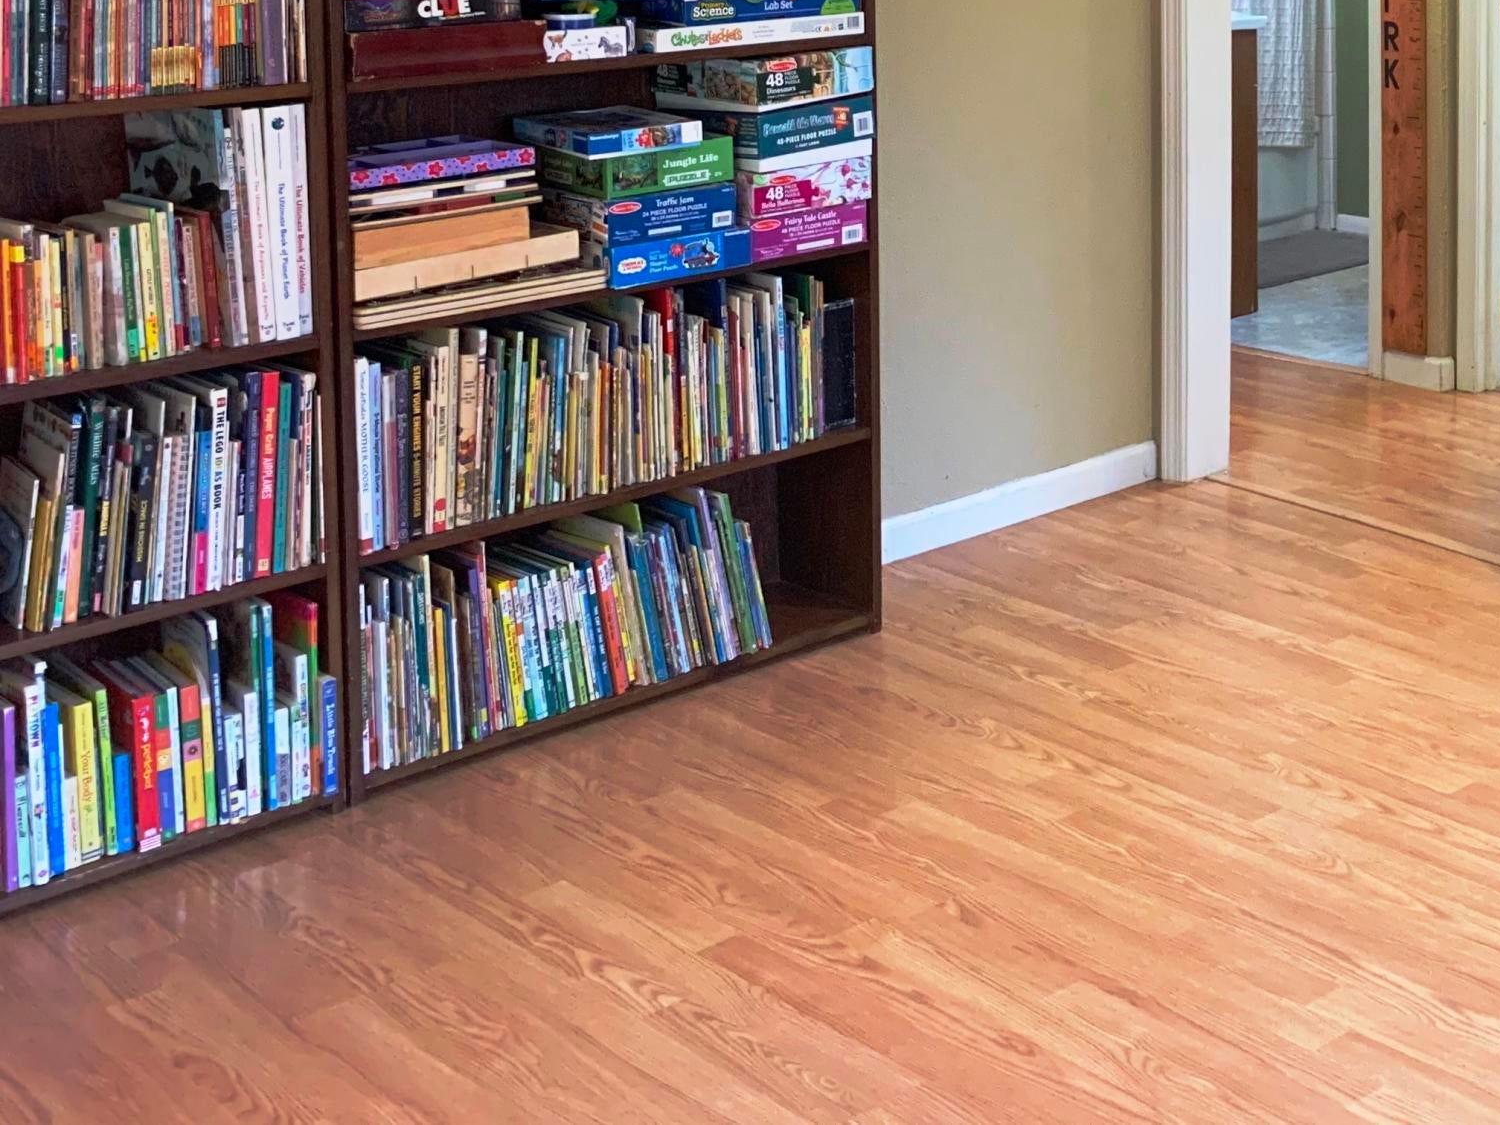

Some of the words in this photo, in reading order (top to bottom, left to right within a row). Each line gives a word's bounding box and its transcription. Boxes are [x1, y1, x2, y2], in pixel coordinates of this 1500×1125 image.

[692, 5, 735, 18] Science
[764, 1, 778, 11] Lab
[780, 0, 793, 10] Set
[765, 73, 784, 87] 48
[766, 86, 796, 96] Dinosaurs
[801, 132, 818, 142] FLOOR
[818, 128, 837, 139] PUZZLE
[663, 155, 697, 169] Jungle
[699, 153, 719, 163] Life
[277, 182, 286, 195] The
[295, 184, 303, 198] The
[765, 186, 784, 200] 48
[279, 196, 287, 228] Ultimate
[650, 208, 667, 216] PIECE
[687, 203, 708, 211] PUZZLE
[656, 196, 678, 207] Traffic
[680, 196, 694, 204] Jam
[296, 199, 304, 232] Ultimate
[784, 216, 802, 226] Fairy
[803, 214, 817, 222] Tale
[817, 210, 837, 221] Castle
[280, 248, 288, 256] of
[297, 234, 305, 253] Book
[282, 257, 290, 279] Planet
[297, 255, 306, 263] of
[283, 281, 291, 300] Earth
[412, 365, 421, 390] START
[413, 391, 422, 414] YOUR
[216, 411, 225, 429] THE
[264, 407, 275, 432] Paper
[90, 421, 103, 459] Wildlife
[215, 431, 224, 454] LEGO
[263, 434, 274, 455] Craft
[360, 422, 369, 462] MOTHER
[413, 417, 421, 451] ENGINES
[90, 464, 100, 486] Atlas
[261, 457, 273, 500] AIRPLANES
[361, 463, 370, 493] GOOSE
[413, 453, 421, 486] 5-MINUTE
[213, 484, 222, 510] BOOK
[413, 488, 421, 518] STORIES
[99, 500, 110, 536] ANIMALS
[139, 499, 149, 521] SPACE
[139, 522, 146, 530] IN
[135, 530, 145, 563] MISSIONS
[325, 704, 335, 728] Little
[326, 729, 335, 747] Blue
[80, 751, 91, 775] Your
[326, 747, 336, 775] Truck
[82, 776, 93, 802] Body
